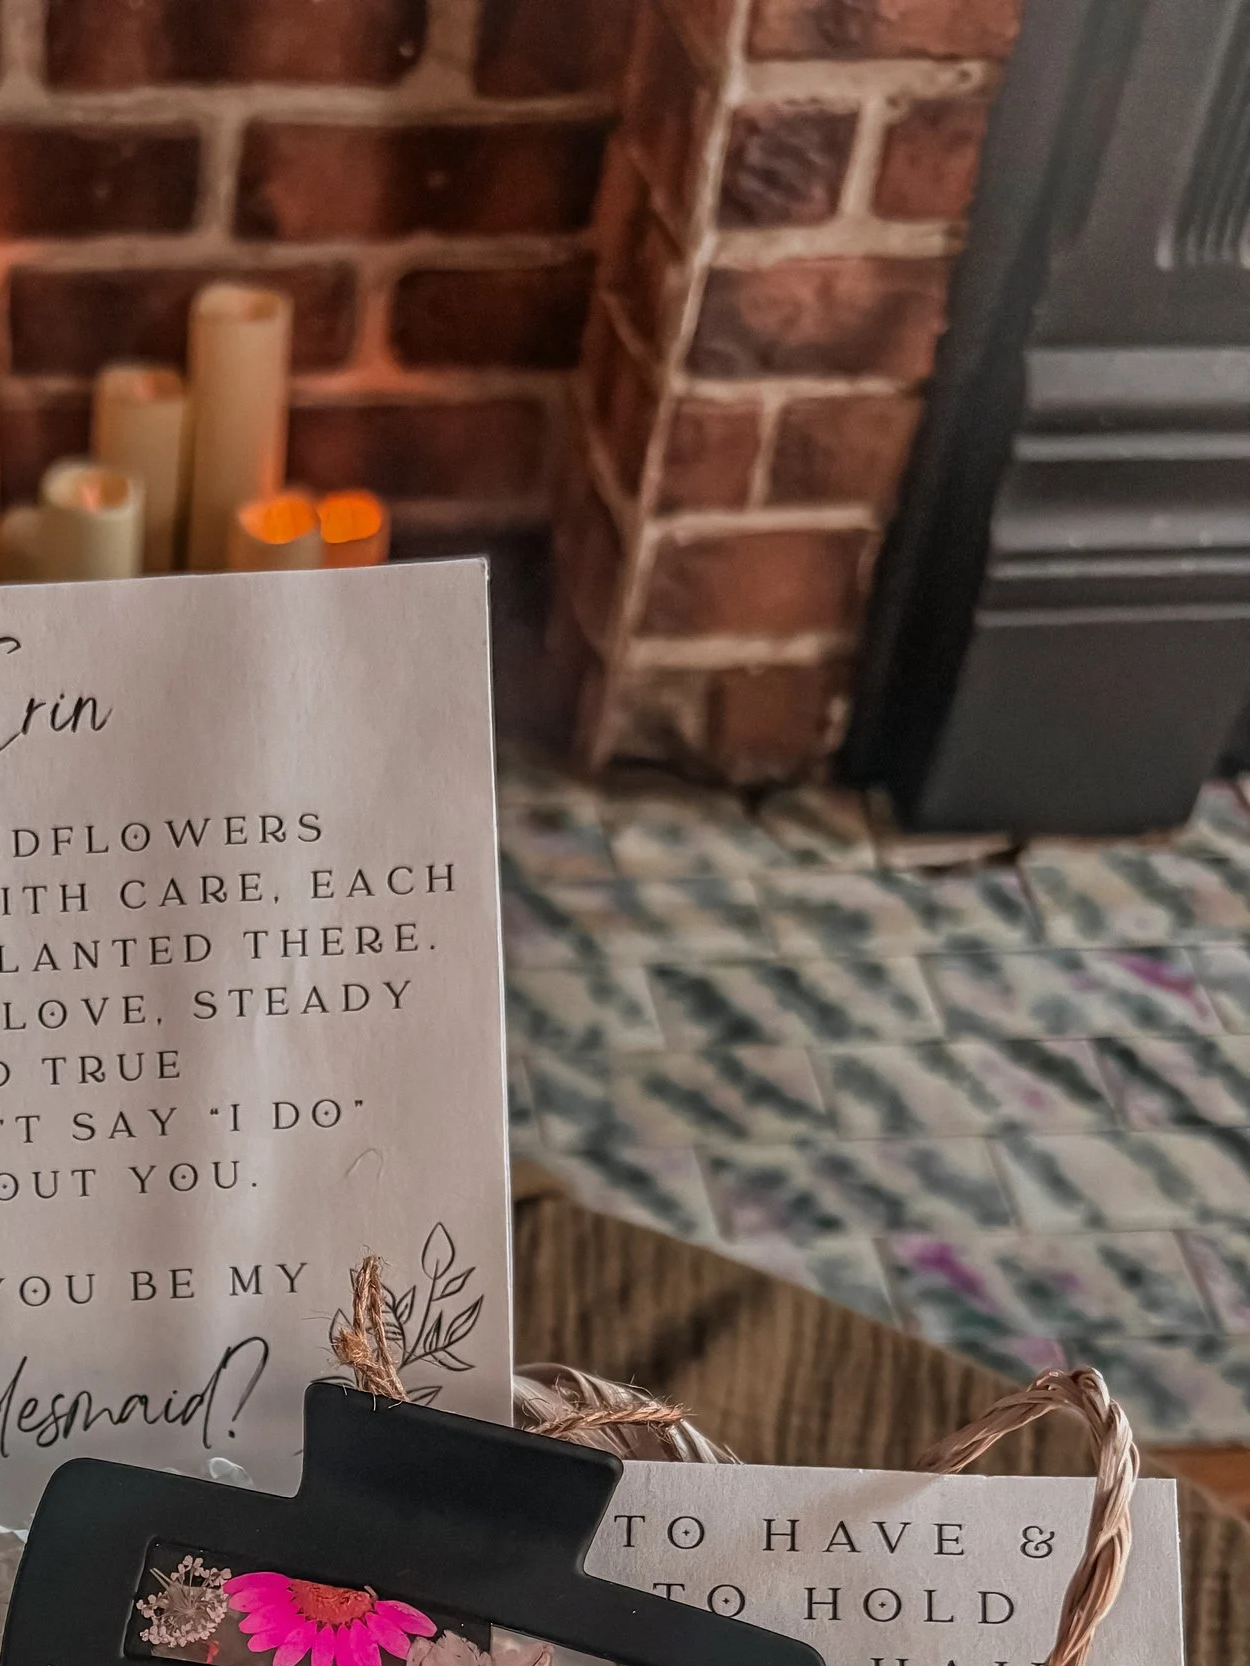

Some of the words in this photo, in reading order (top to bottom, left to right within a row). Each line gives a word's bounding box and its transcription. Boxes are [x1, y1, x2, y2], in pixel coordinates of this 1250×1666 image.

[120, 873, 279, 909] CARE,
[311, 864, 454, 899] EACH
[243, 923, 435, 959] THERE.
[3, 995, 162, 1030] LOVE,
[194, 980, 411, 1019] STEADY
[42, 1050, 180, 1085] TRUE
[72, 1107, 177, 1141] SAY
[128, 1161, 257, 1193] YOU.
[130, 1268, 194, 1301] BE
[230, 1262, 308, 1296] MY
[614, 1515, 705, 1549] TO
[762, 1519, 965, 1555] HAVE
[1020, 1526, 1055, 1558] &
[653, 1583, 745, 1618] TO
[804, 1587, 1015, 1624] HOLD
